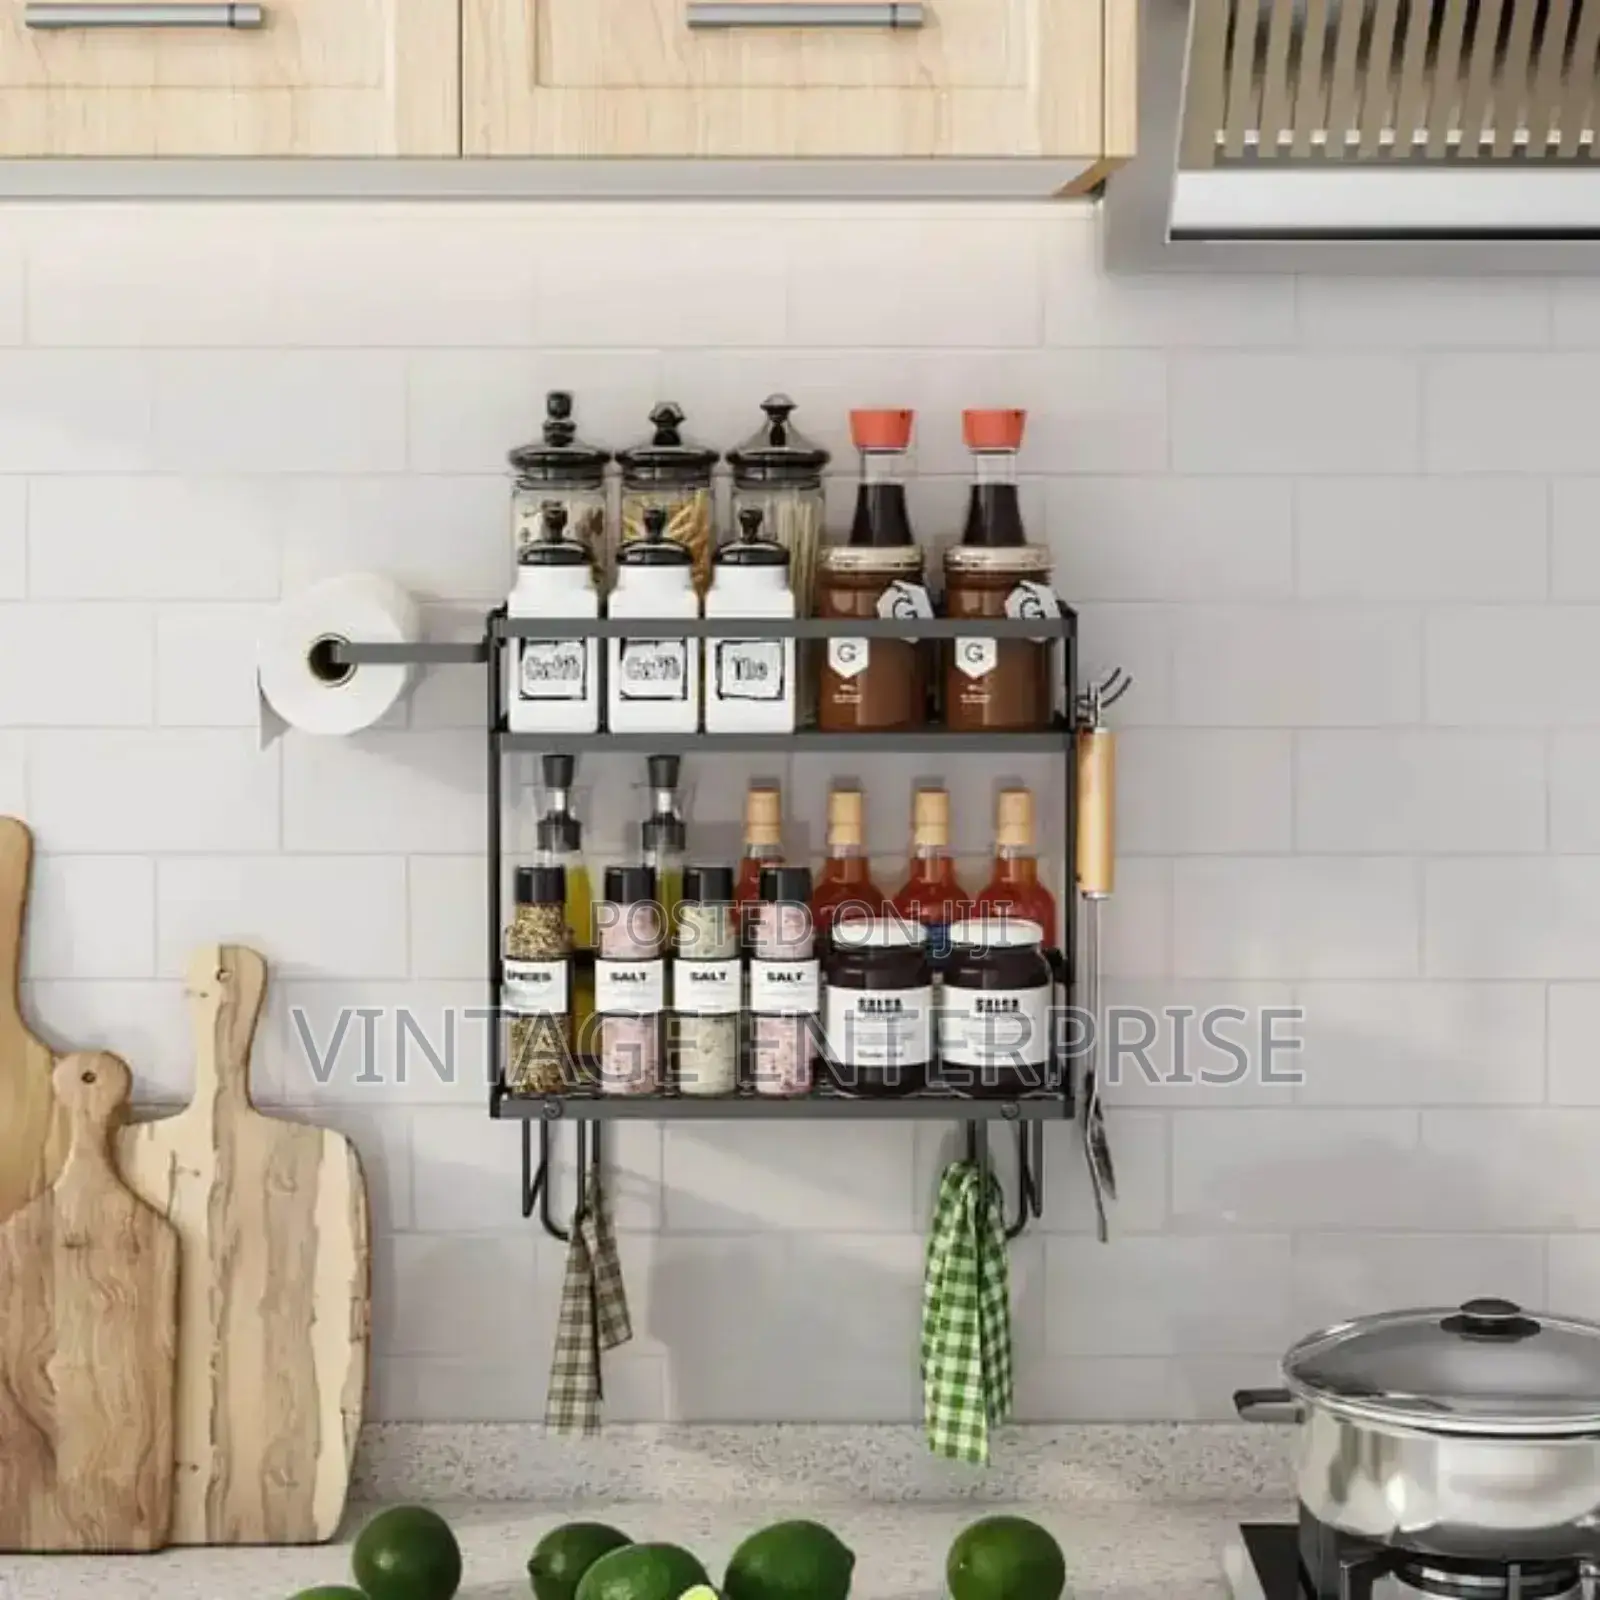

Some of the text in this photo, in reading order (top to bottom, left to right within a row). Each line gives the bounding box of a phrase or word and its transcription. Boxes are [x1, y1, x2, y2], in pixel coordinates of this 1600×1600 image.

[837, 643, 857, 663] G
[964, 643, 984, 663] G
[609, 971, 647, 982] SALT
[690, 971, 727, 982] SALT
[767, 971, 804, 982] SALT
